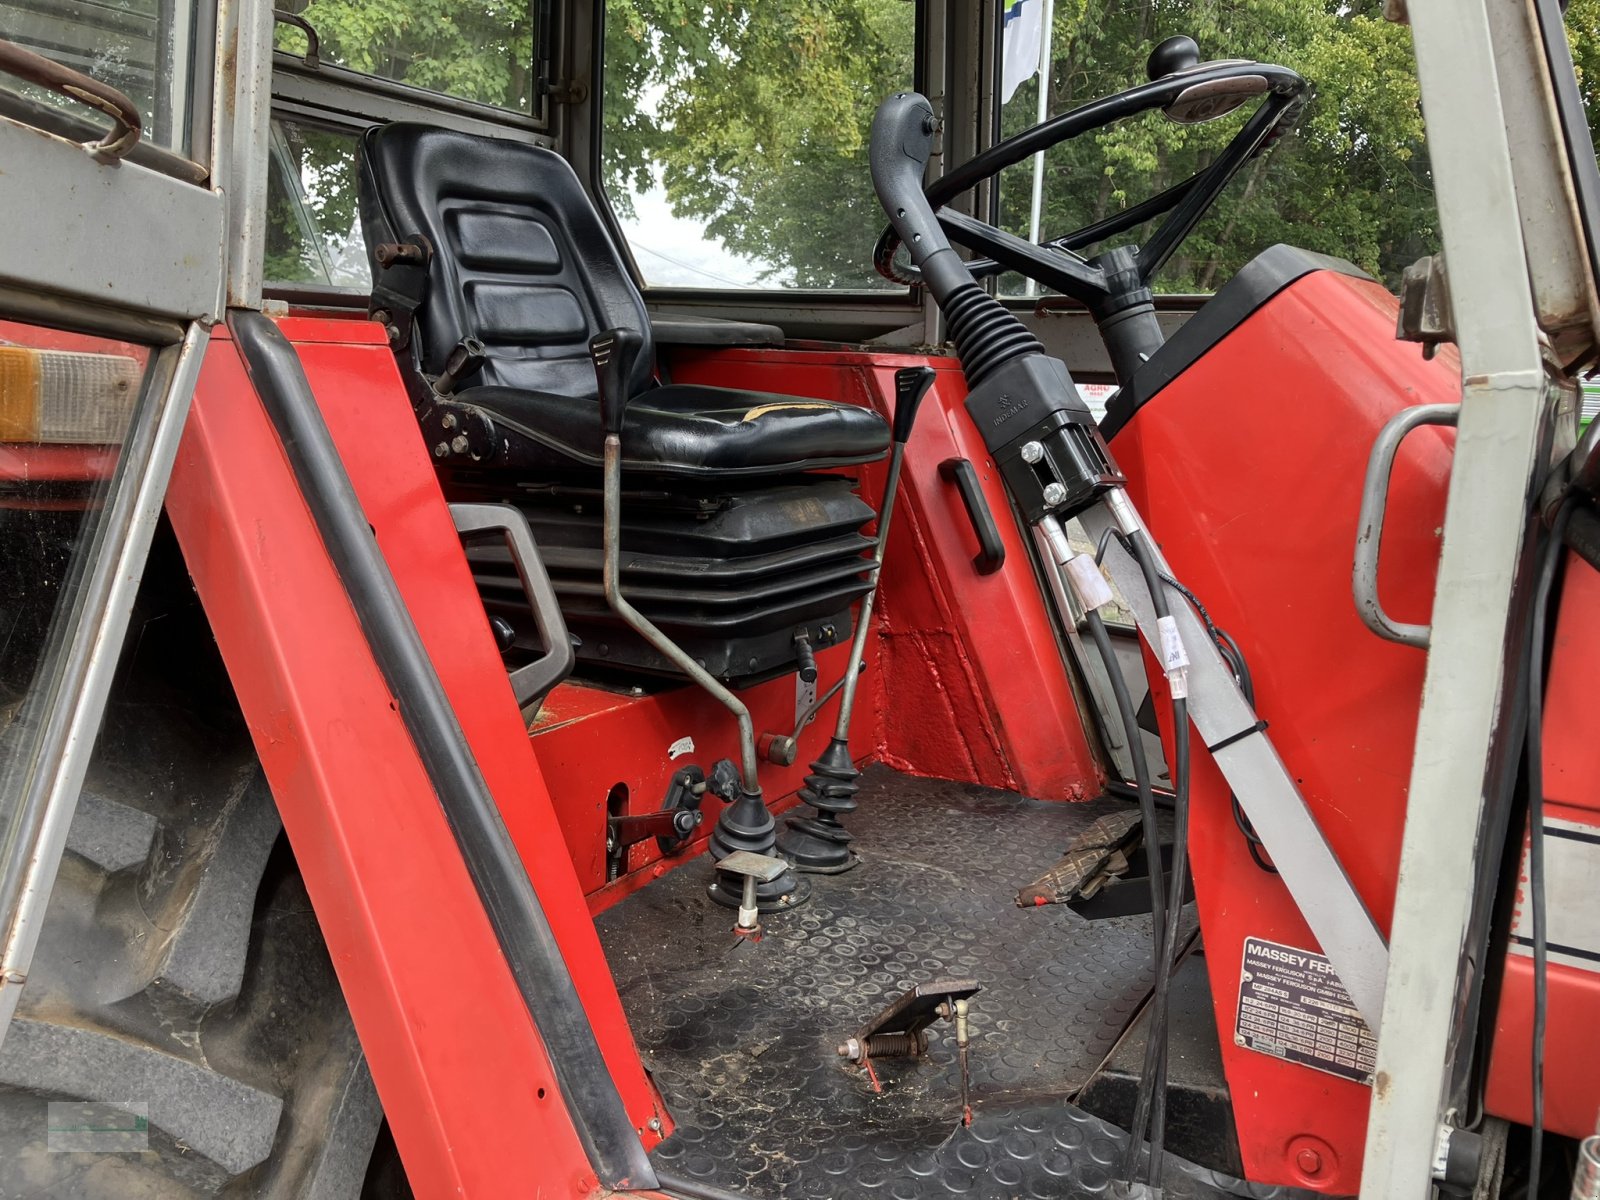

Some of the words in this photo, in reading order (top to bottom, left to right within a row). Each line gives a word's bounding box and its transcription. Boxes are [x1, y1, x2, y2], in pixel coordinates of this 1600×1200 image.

[1247, 959, 1271, 969] MASSEY
[1272, 966, 1305, 978] FERGUSON
[1248, 944, 1307, 967] MASSEY
[1309, 960, 1335, 975] FER
[1257, 972, 1281, 982] MASSEY
[1283, 979, 1316, 992] FERGUSON
